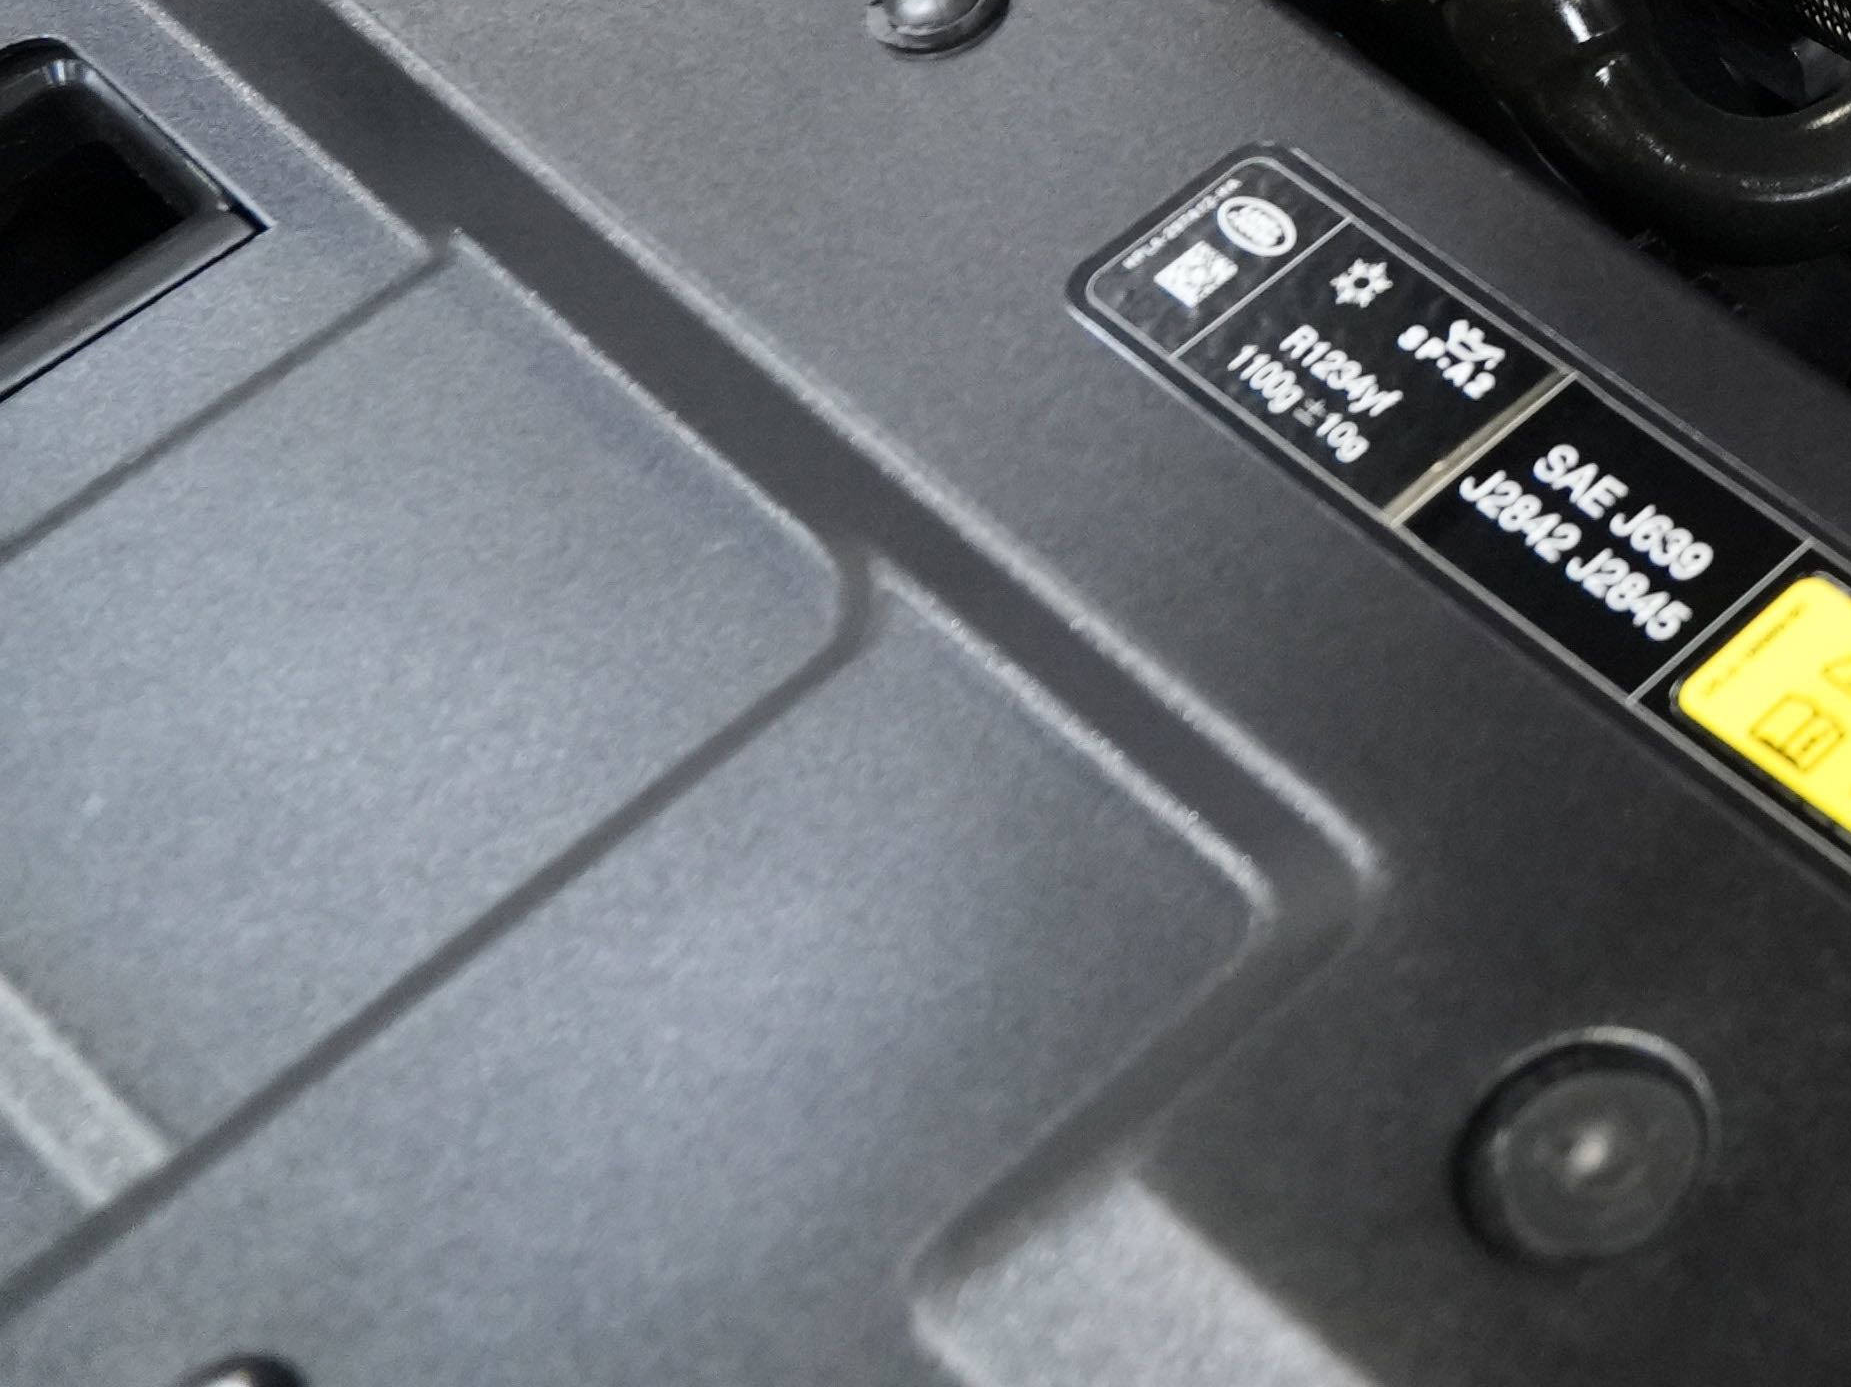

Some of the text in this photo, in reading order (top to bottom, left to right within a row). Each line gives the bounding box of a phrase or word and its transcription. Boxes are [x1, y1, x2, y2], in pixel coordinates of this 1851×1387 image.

[1278, 324, 1404, 418] R1234yf
[1458, 470, 1693, 642] J2842 J2845
[1533, 443, 1714, 581] SAE J639
